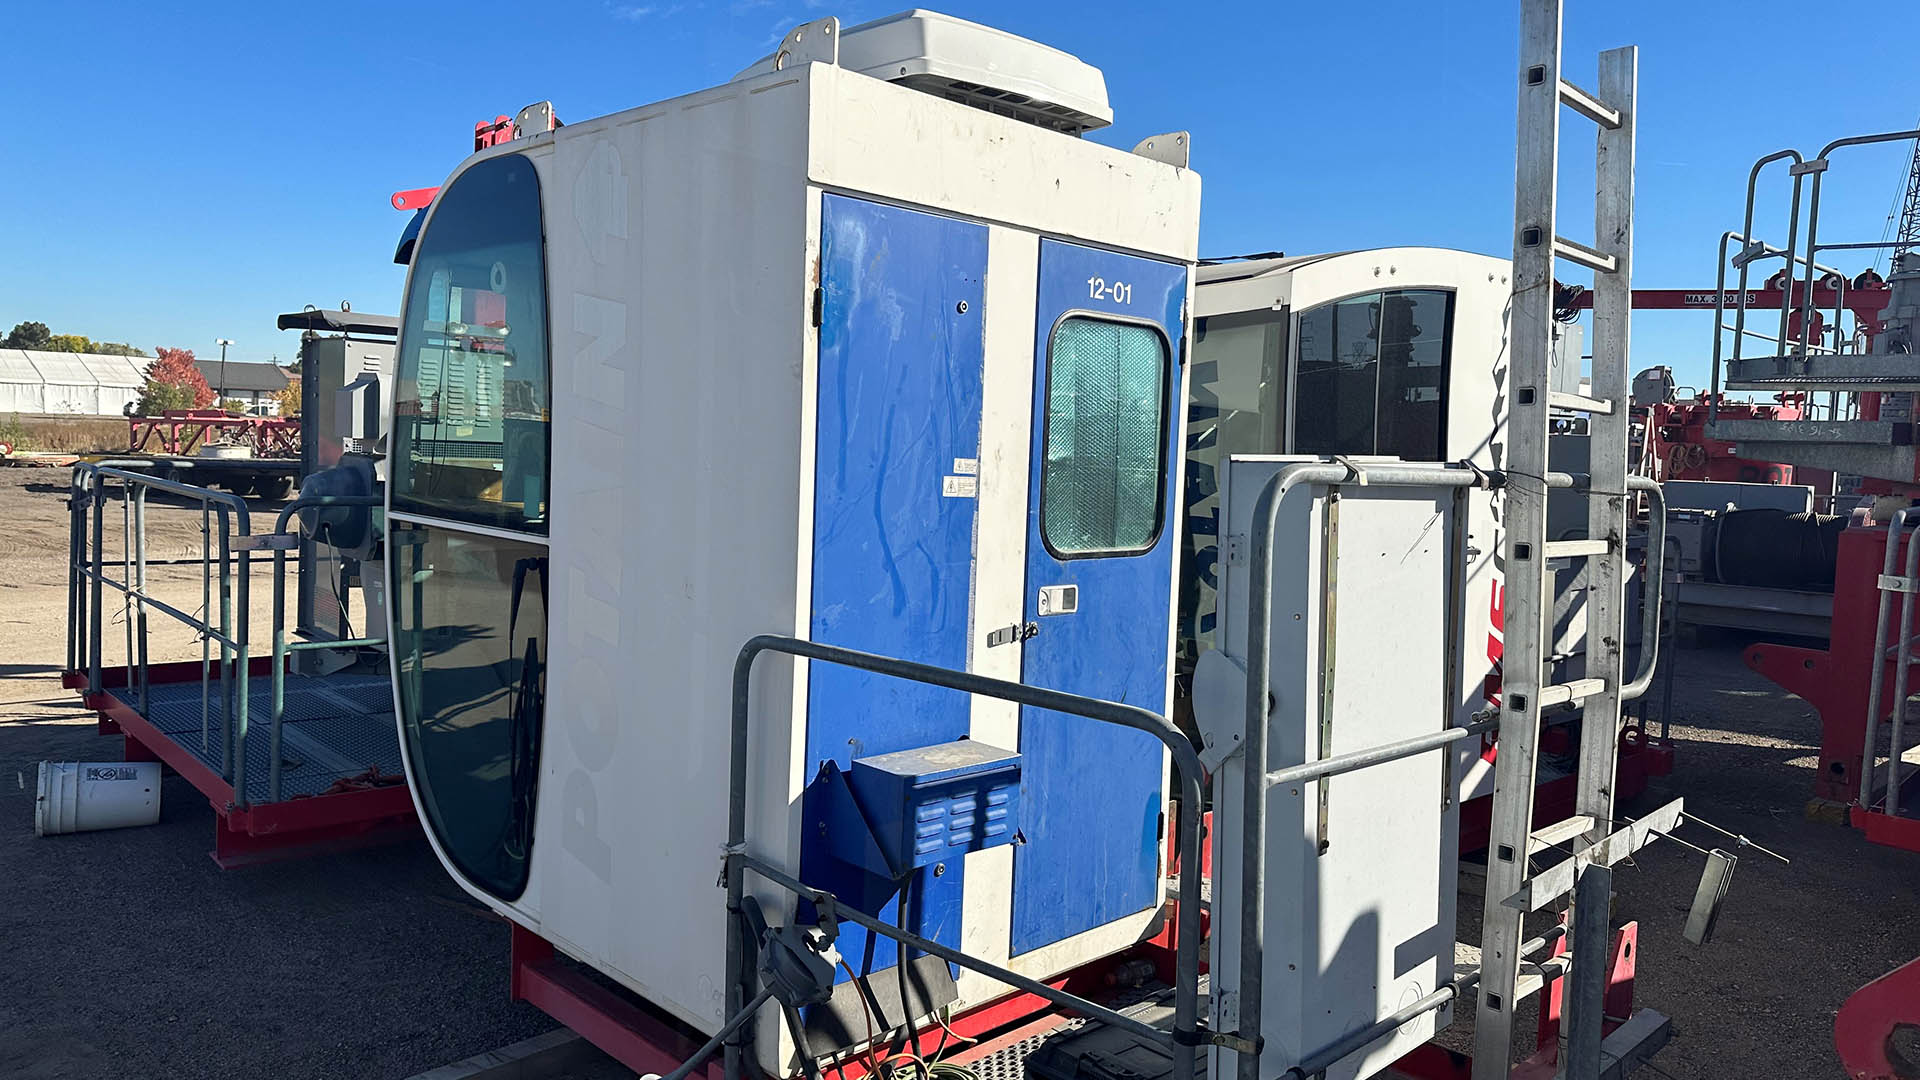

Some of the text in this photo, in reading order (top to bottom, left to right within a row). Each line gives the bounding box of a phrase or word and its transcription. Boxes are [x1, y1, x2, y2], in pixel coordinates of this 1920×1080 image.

[1087, 276, 1132, 305] 12-01
[1685, 295, 1708, 303] MAX.
[1712, 295, 1734, 303] 300
